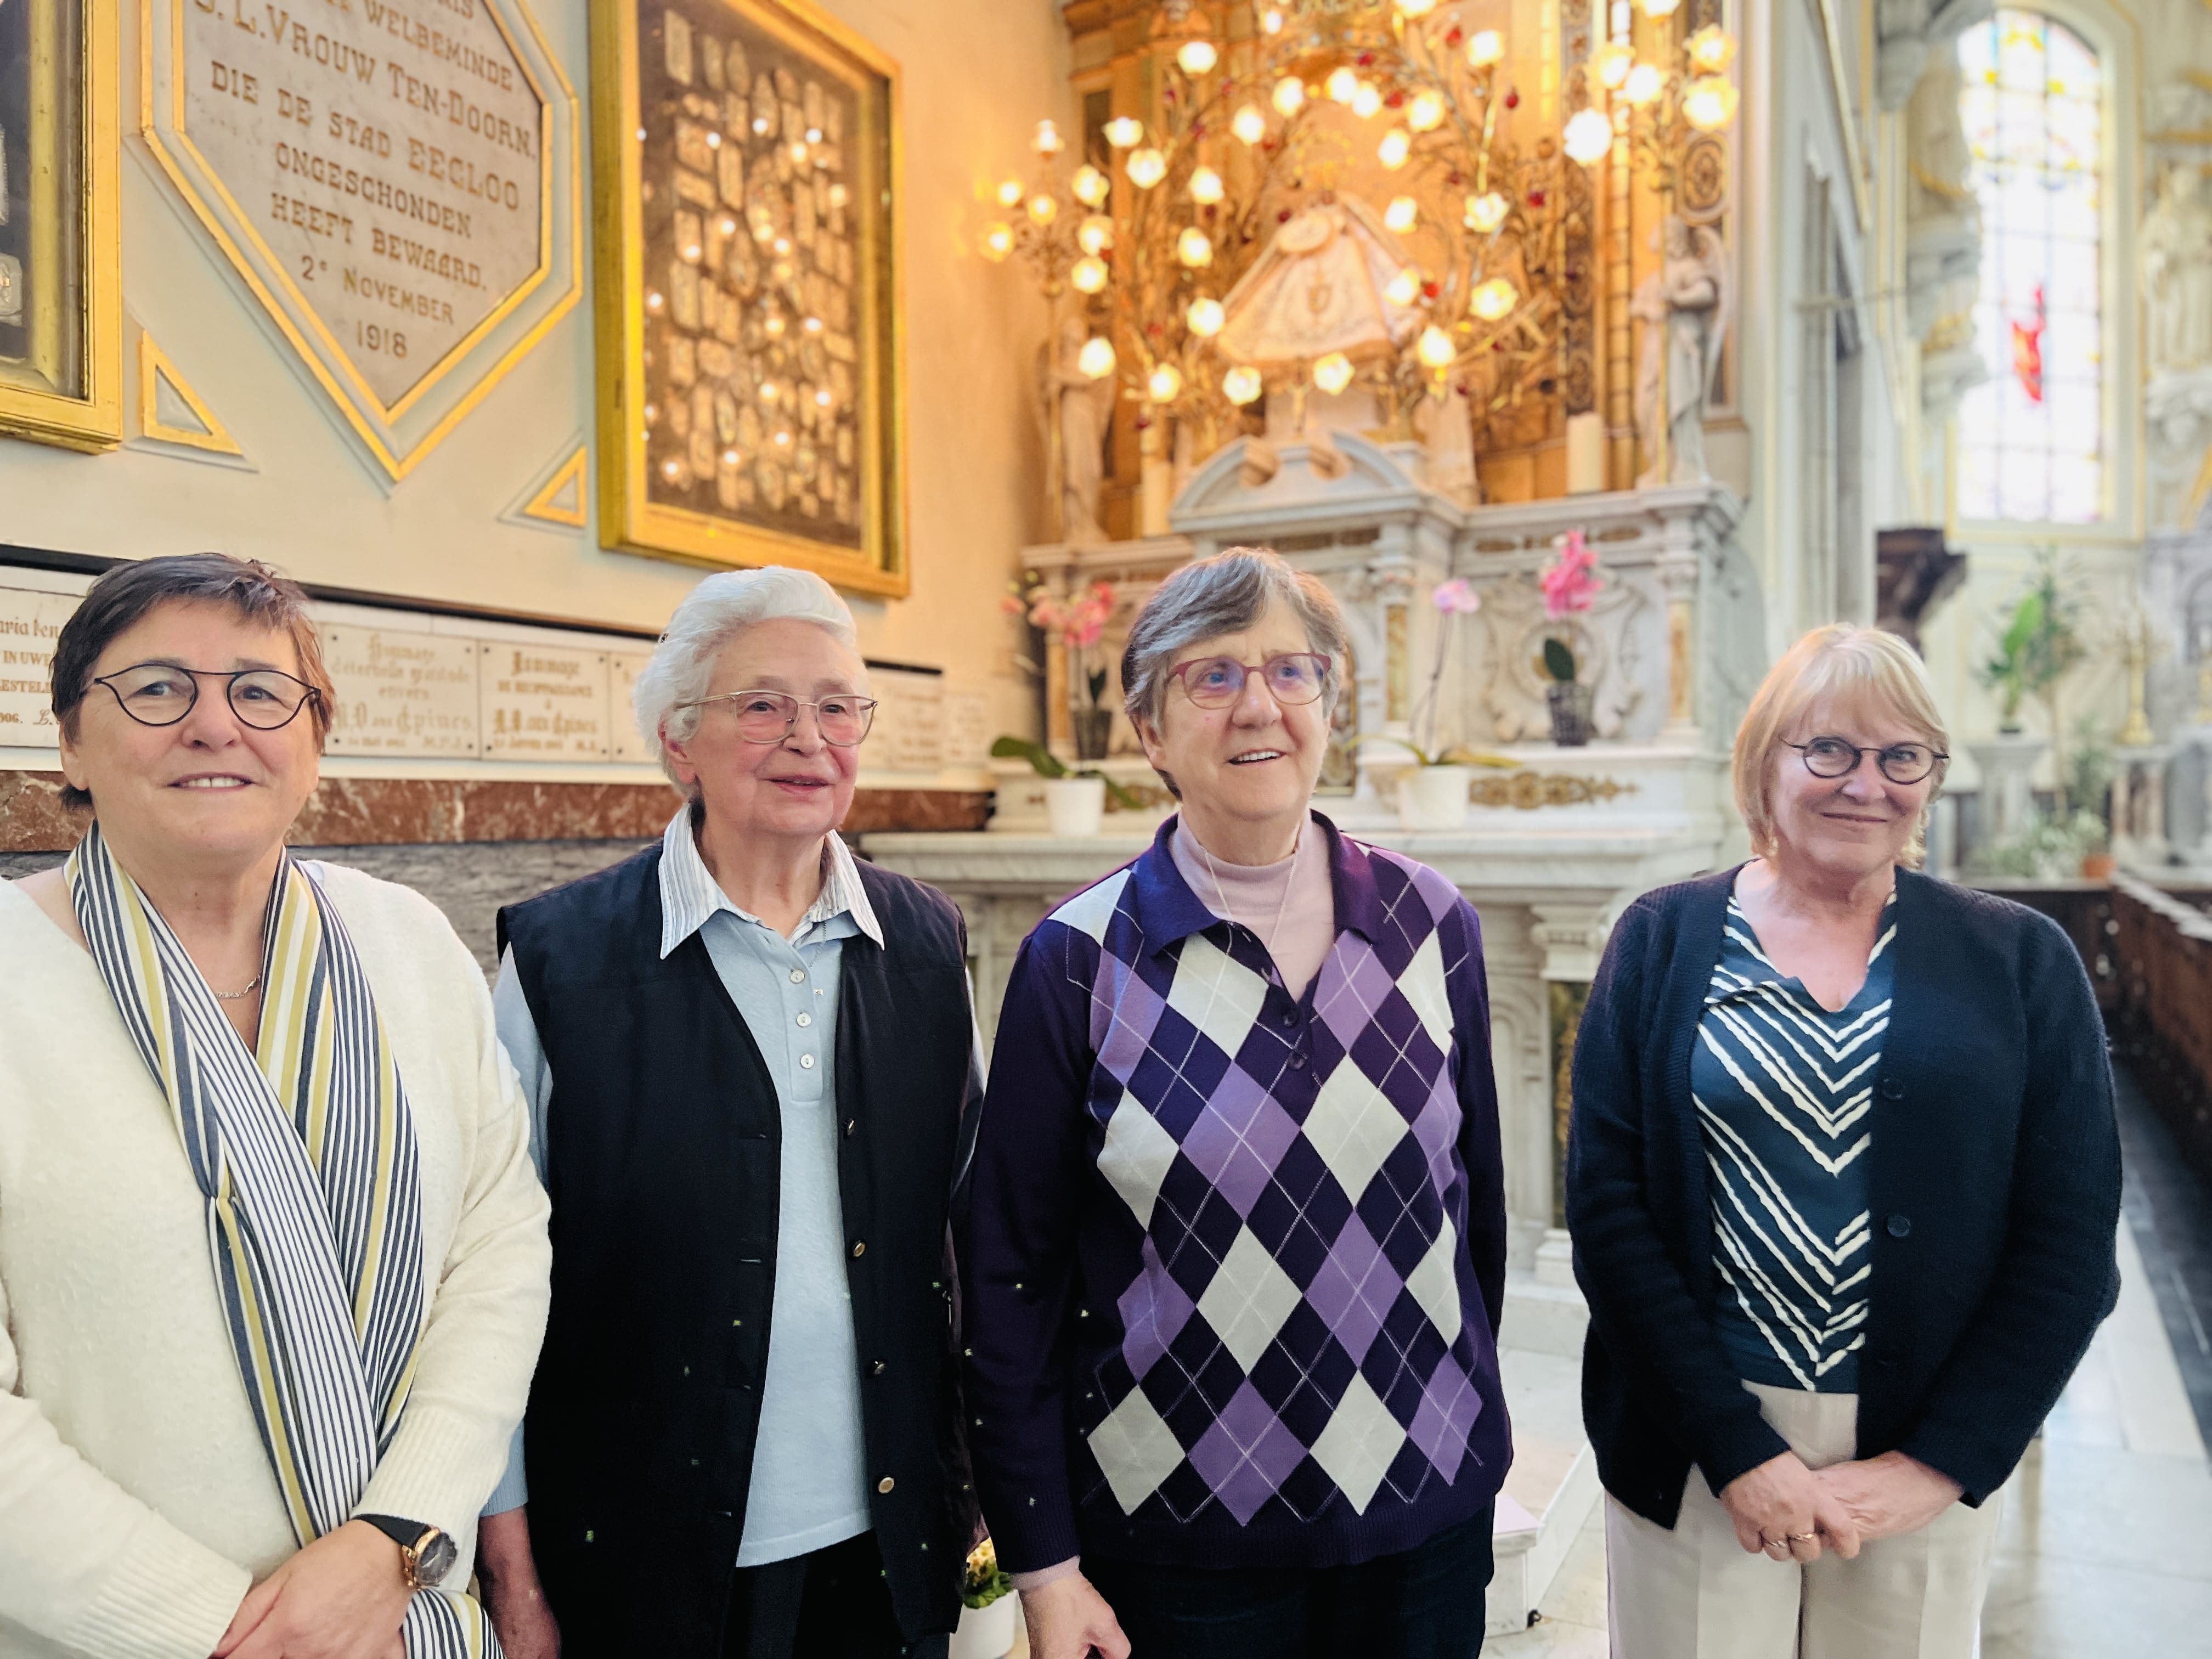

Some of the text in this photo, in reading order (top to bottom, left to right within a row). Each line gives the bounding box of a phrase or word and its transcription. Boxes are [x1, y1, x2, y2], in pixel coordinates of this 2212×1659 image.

[364, 0, 512, 92] WELBEMINDE
[211, 60, 518, 211] DIE DE STAD EECLOO
[276, 142, 472, 238] ONGESCHONDEN
[272, 193, 487, 291] HEEFT BEWAARD.
[343, 268, 454, 325] NOVEMBER
[358, 320, 408, 358] 1918
